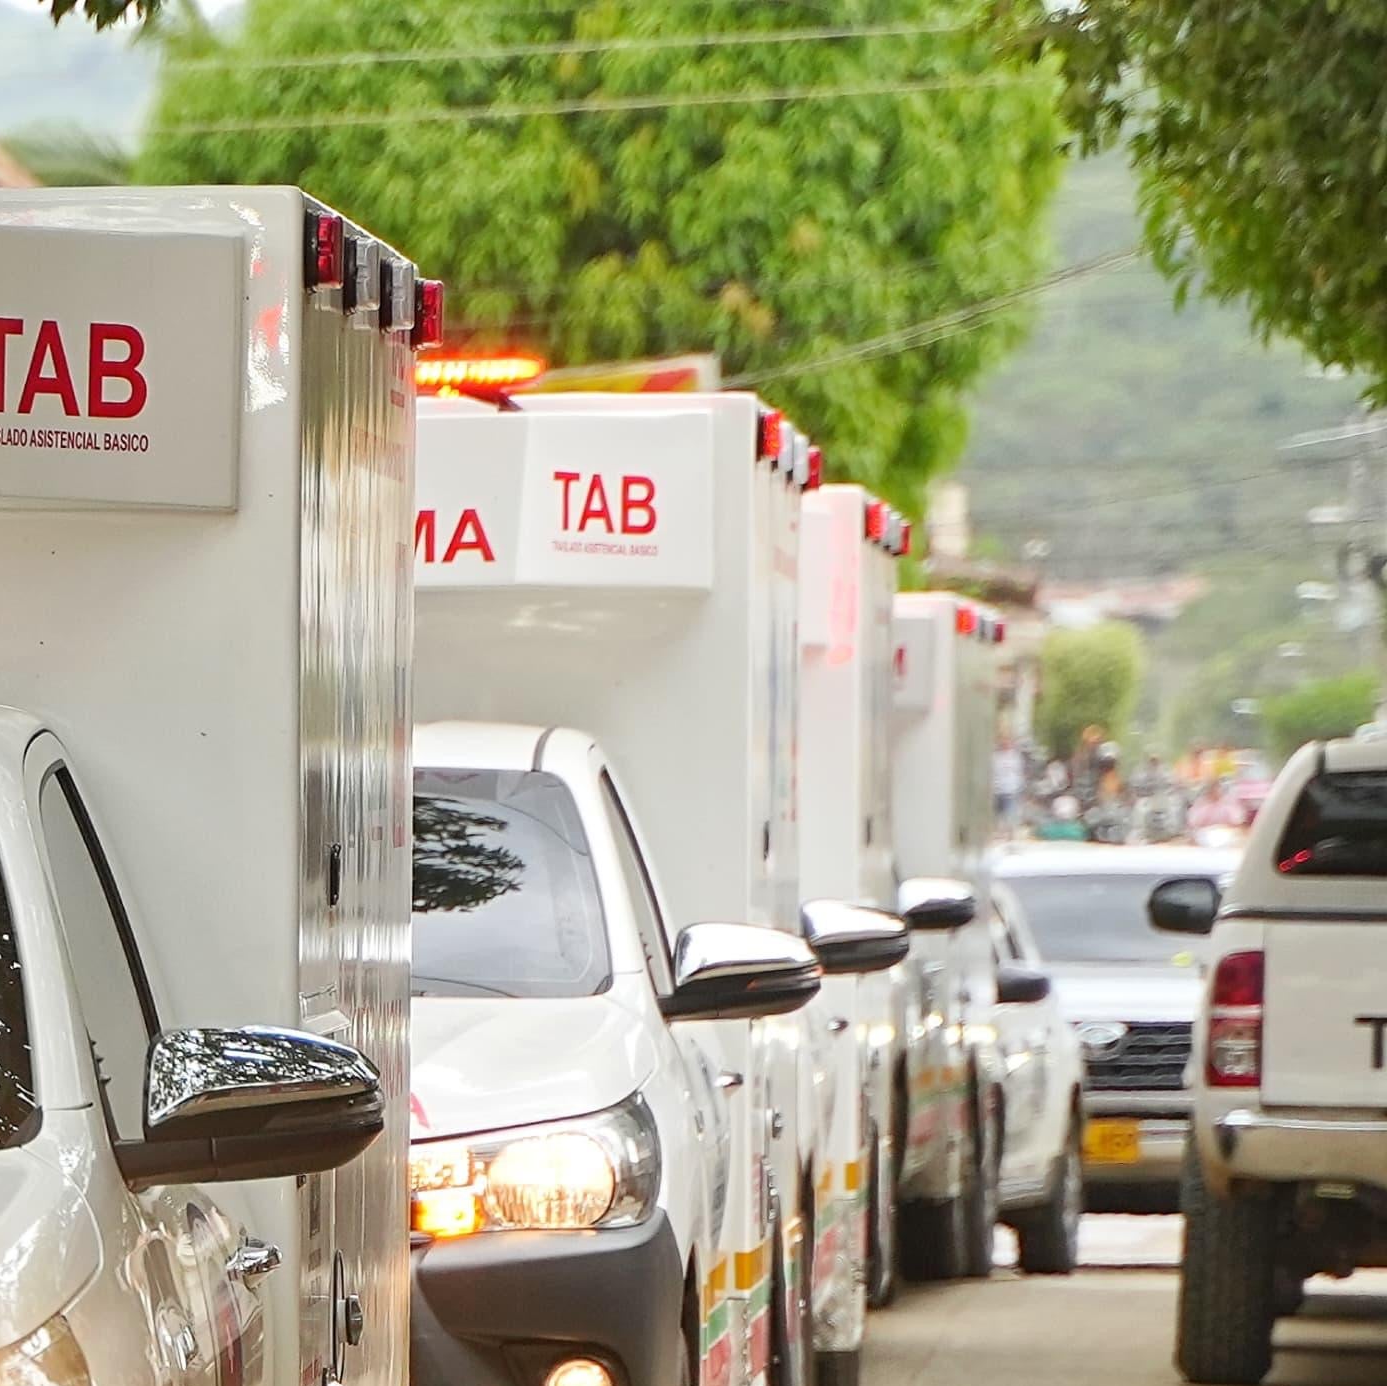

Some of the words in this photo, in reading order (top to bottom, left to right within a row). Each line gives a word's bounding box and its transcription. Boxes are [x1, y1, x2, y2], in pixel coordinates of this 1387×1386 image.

[29, 430, 101, 450] ASISTENCIAL
[104, 433, 149, 452] BASICO
[553, 471, 657, 534] TAB
